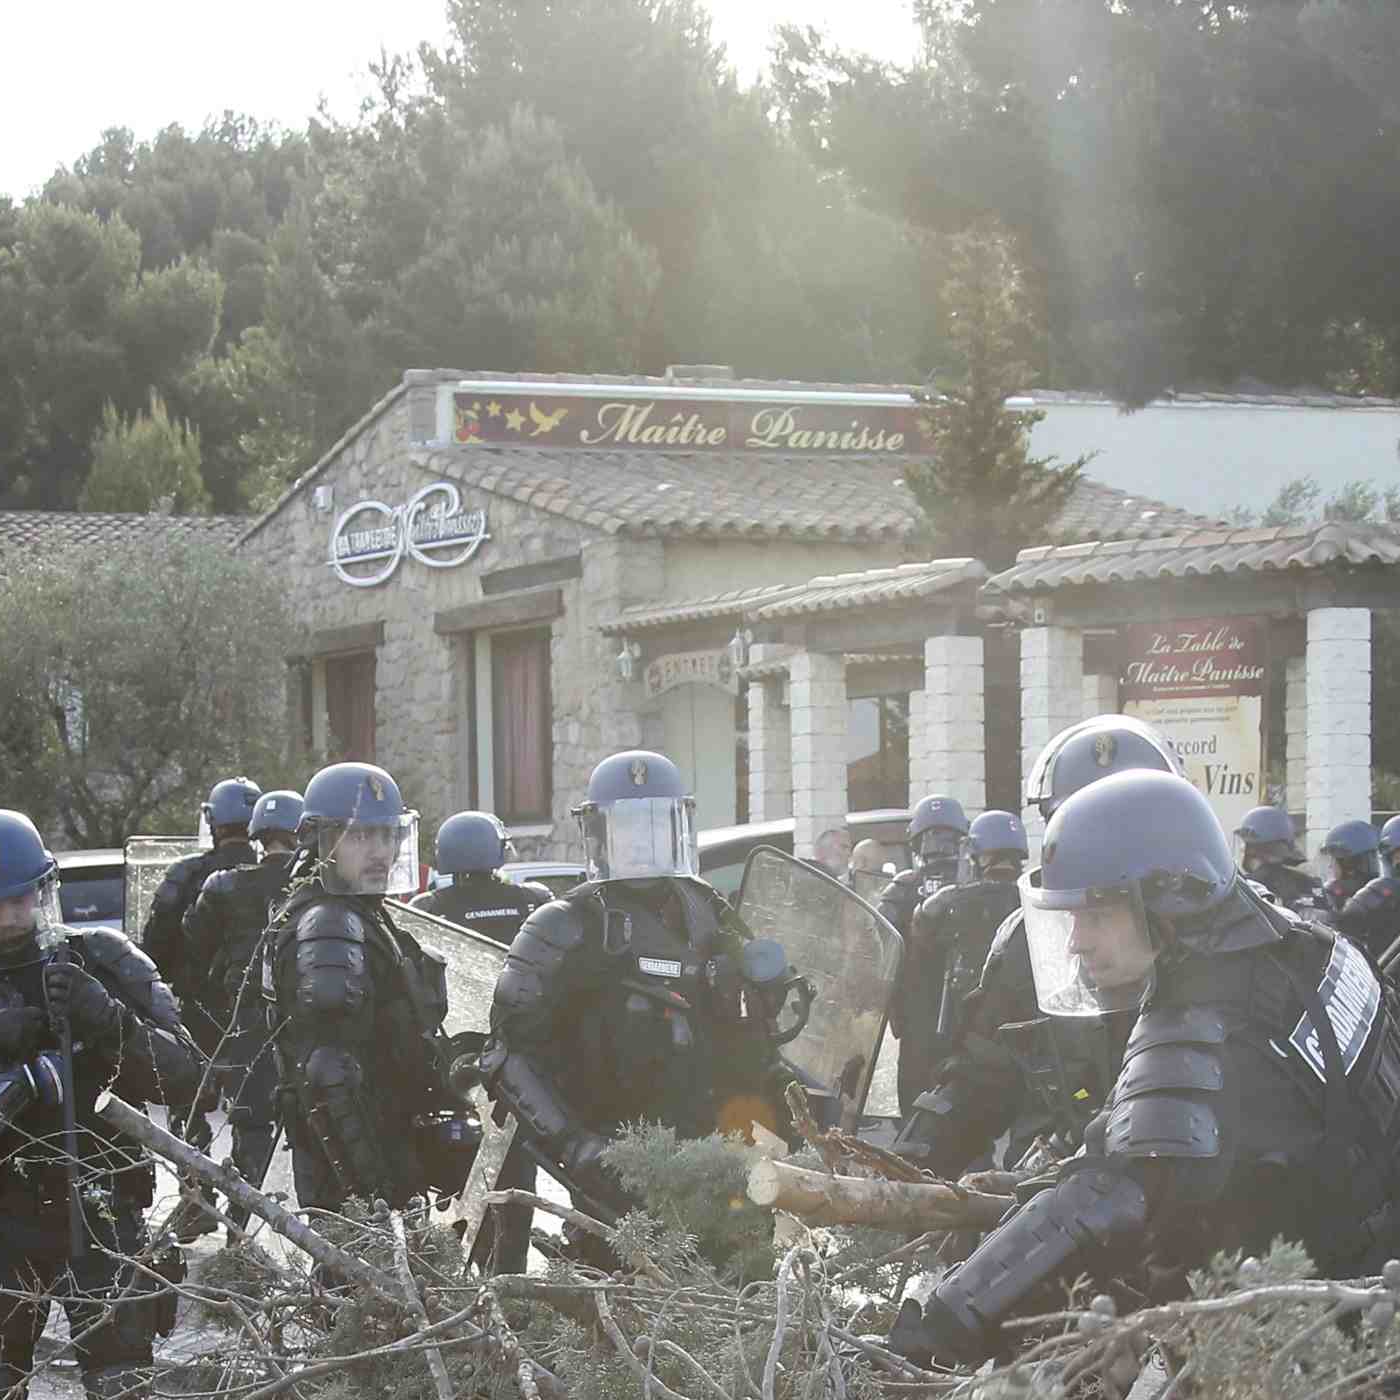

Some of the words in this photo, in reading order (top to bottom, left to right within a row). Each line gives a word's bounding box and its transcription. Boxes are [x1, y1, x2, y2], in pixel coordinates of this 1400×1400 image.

[580, 402, 727, 445] Maître
[746, 406, 905, 451] Panisse
[1190, 656, 1265, 683] Panisse
[1176, 735, 1217, 755] ccord
[1204, 763, 1256, 795] Vins
